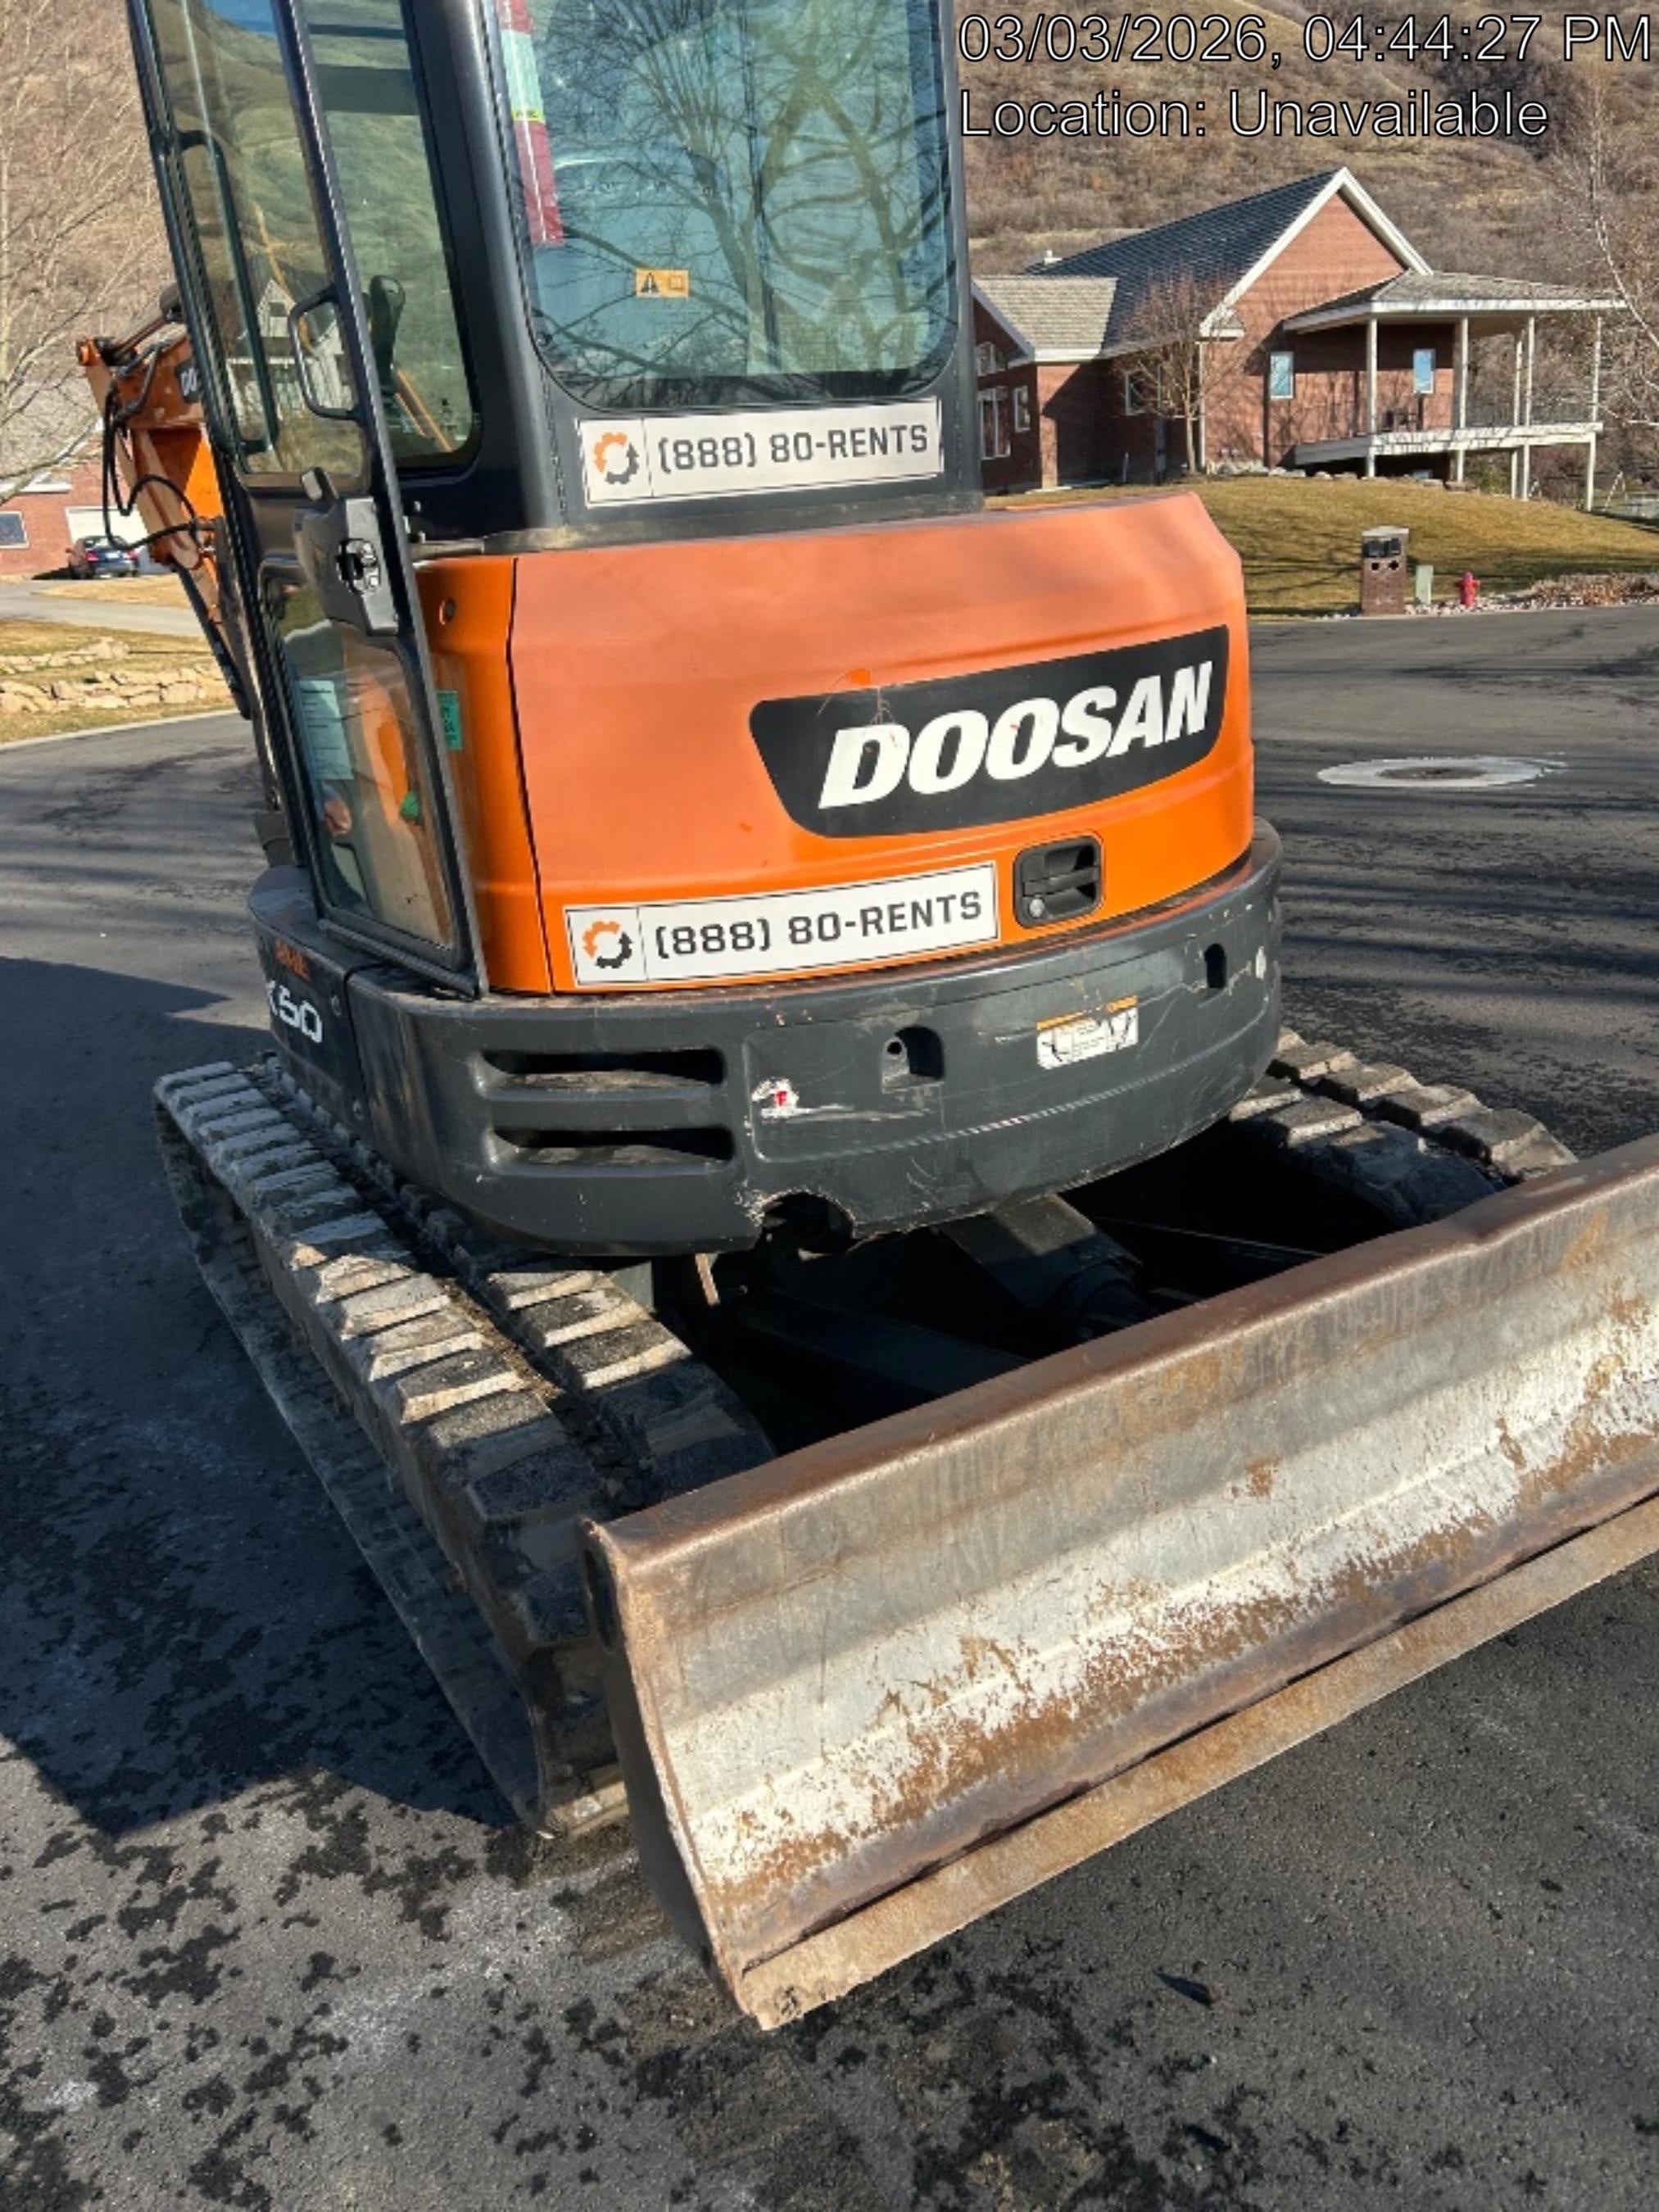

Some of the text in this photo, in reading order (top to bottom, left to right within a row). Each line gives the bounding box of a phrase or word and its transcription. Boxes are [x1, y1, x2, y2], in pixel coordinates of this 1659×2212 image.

[658, 424, 929, 474] (888) 80-RENTS
[818, 660, 1213, 809] DOOSAN
[655, 891, 982, 959] (888) 80-RENTS
